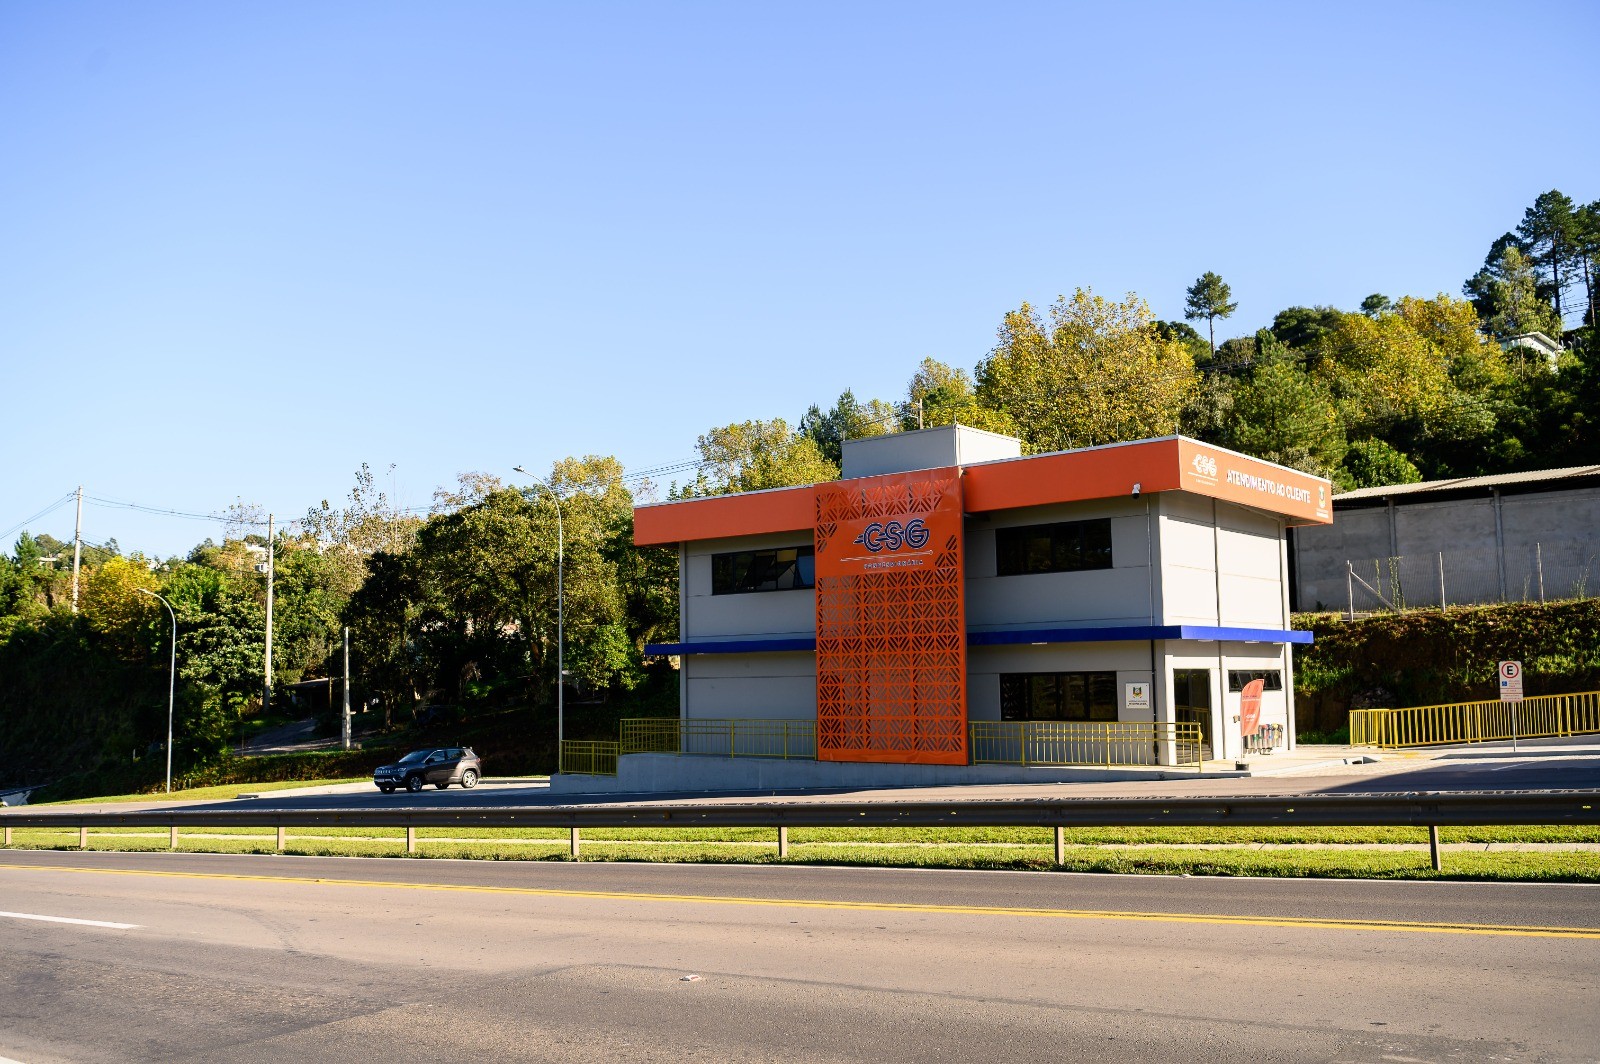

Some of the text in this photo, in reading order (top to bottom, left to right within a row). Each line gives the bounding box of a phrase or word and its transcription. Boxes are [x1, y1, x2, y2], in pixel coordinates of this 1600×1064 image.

[1193, 453, 1217, 476] CSG
[1226, 469, 1276, 495] ATENDIMENTO
[1276, 483, 1285, 497] AO
[1286, 485, 1310, 503] CLIENTE
[859, 518, 930, 552] CSG
[1506, 665, 1514, 676] E
